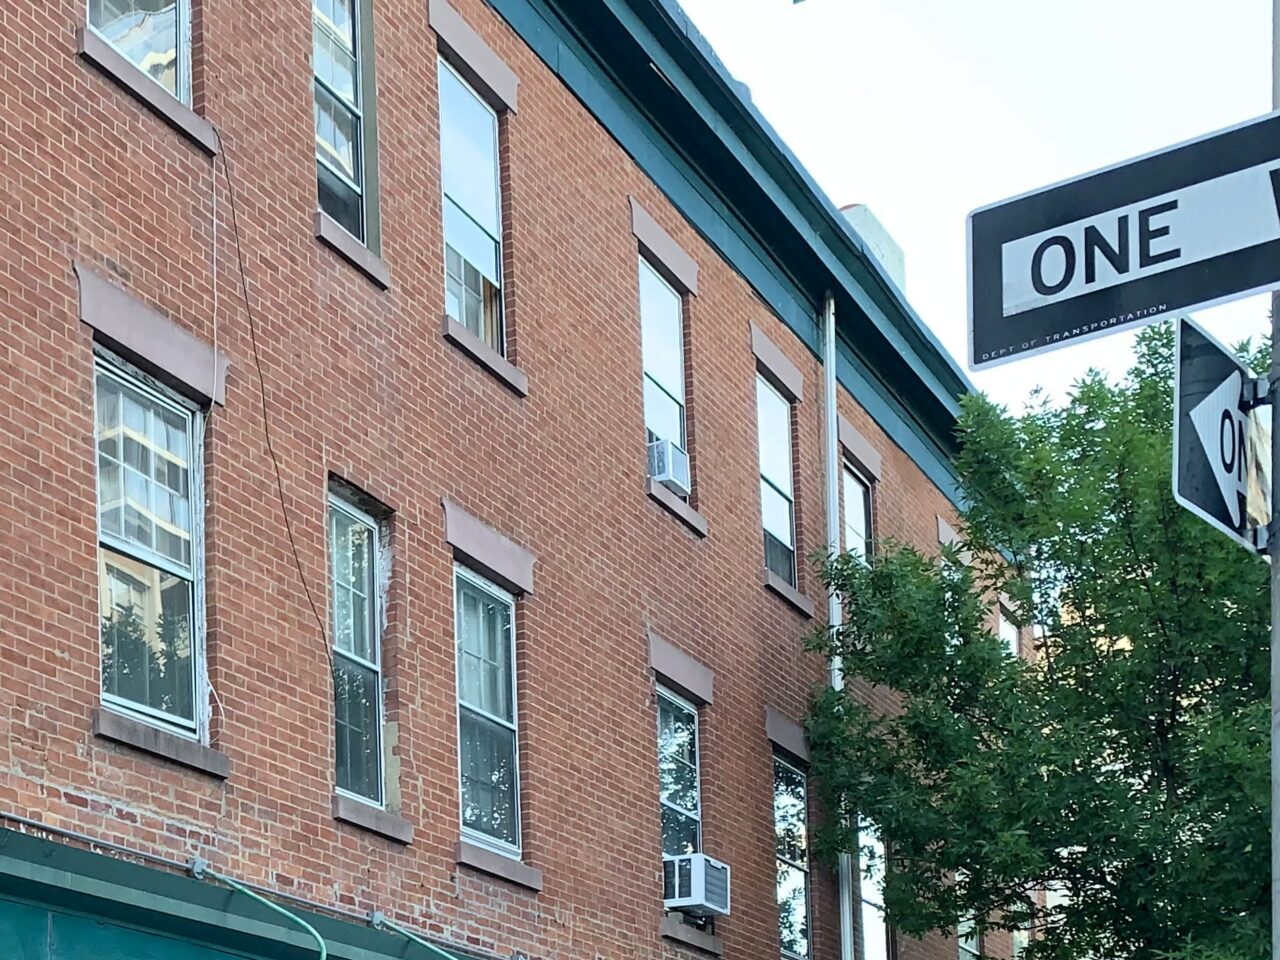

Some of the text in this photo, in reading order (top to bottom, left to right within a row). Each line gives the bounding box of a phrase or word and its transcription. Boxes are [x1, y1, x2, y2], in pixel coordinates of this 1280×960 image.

[1031, 199, 1181, 297] ONE
[982, 303, 1168, 361] DEPT OF TRANSPORTATION
